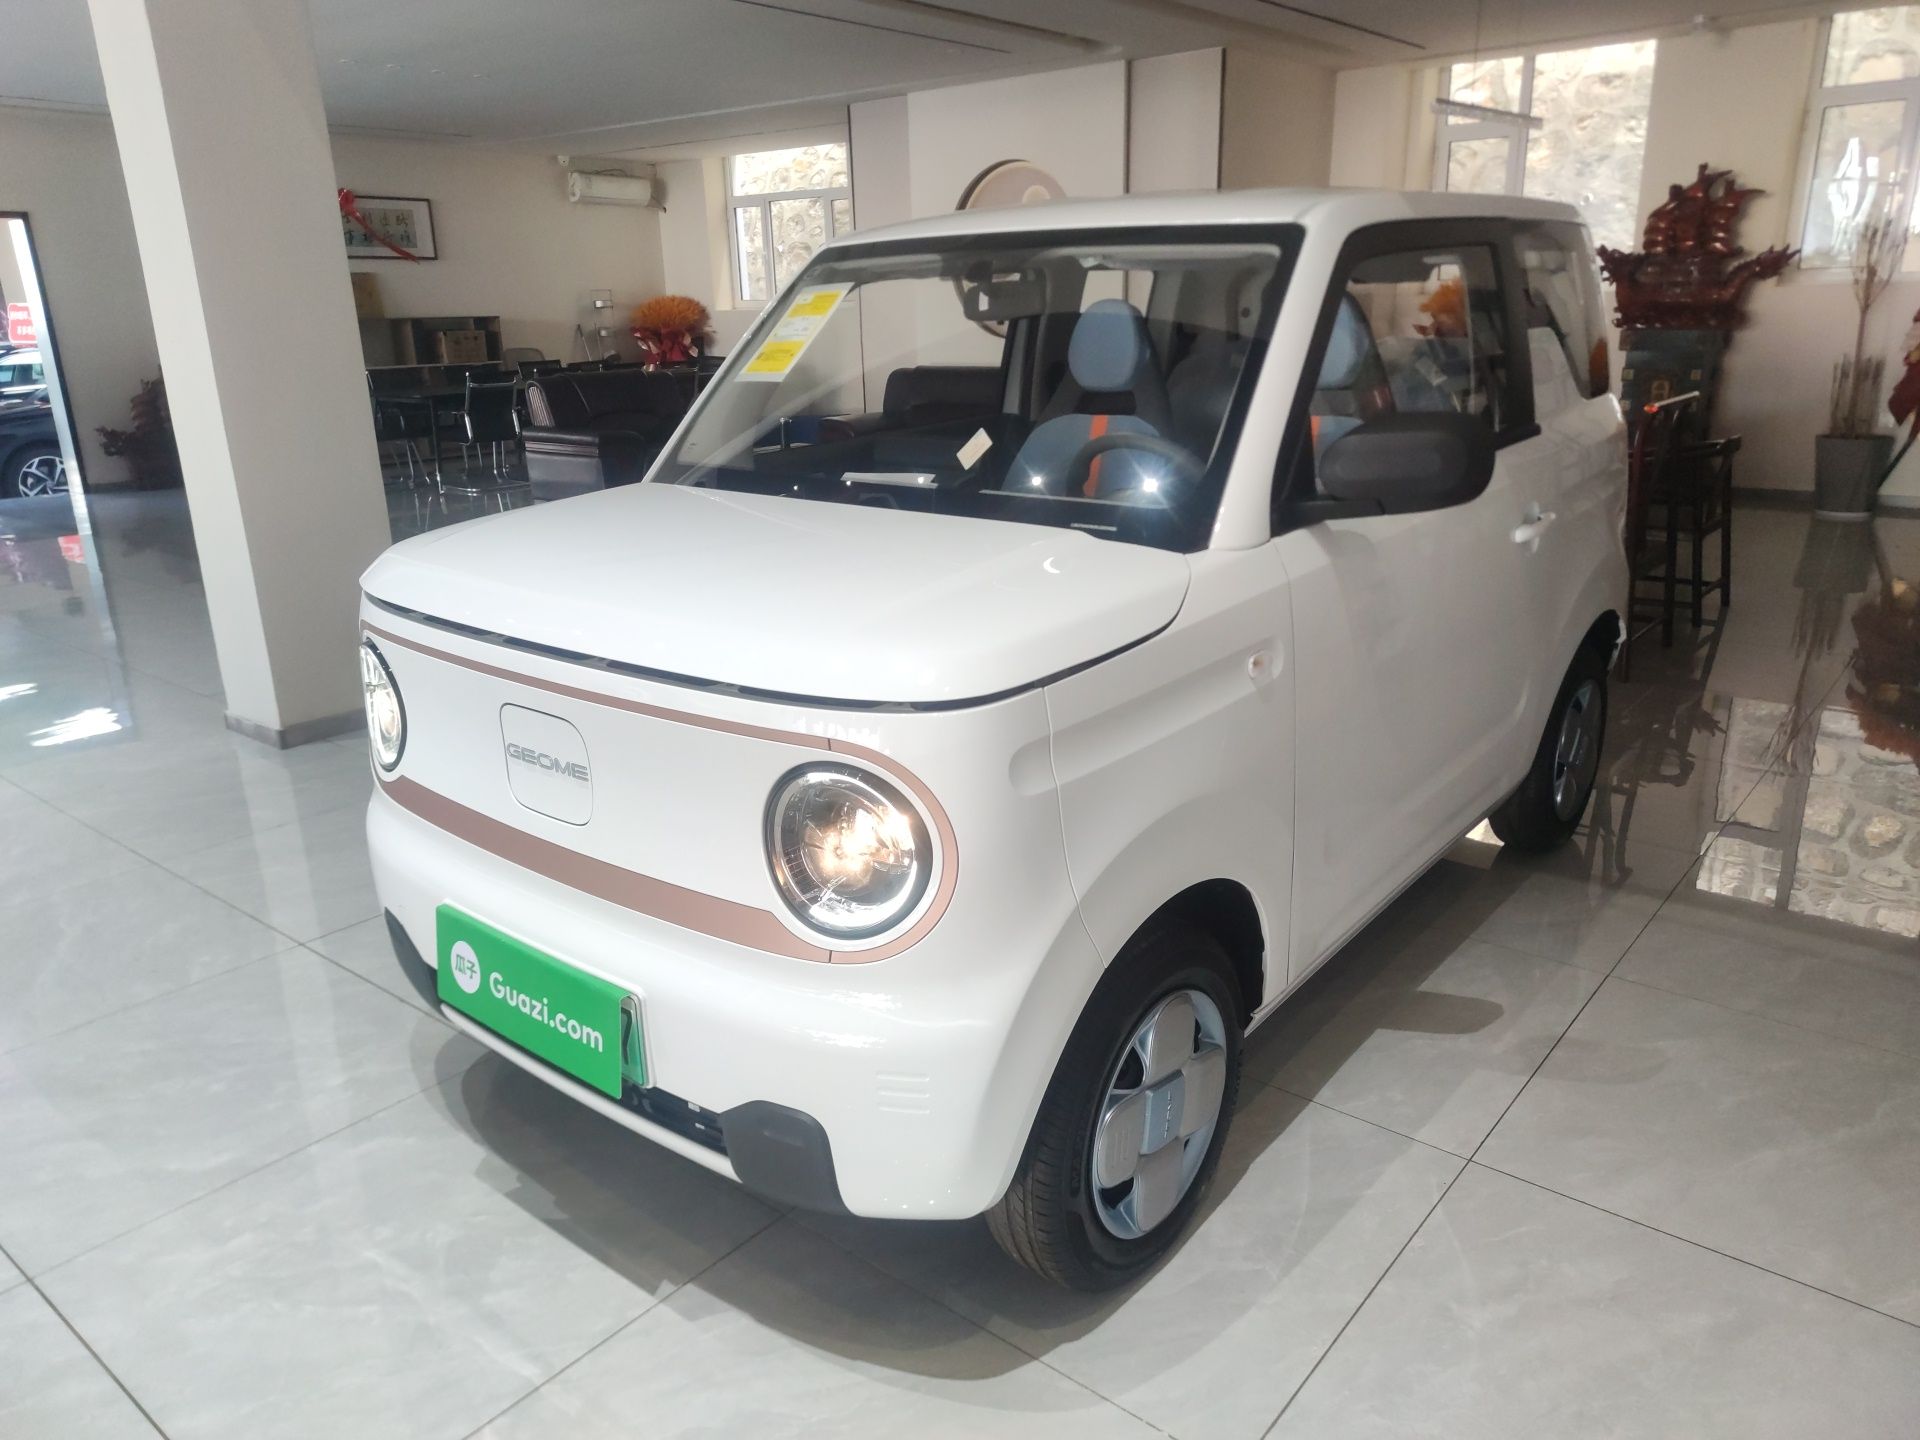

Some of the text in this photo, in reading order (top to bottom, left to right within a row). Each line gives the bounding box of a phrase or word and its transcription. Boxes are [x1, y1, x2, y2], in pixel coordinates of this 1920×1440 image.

[506, 742, 590, 782] GEOME
[454, 953, 478, 980] 瓜子
[489, 971, 604, 1053] Guazi.com
